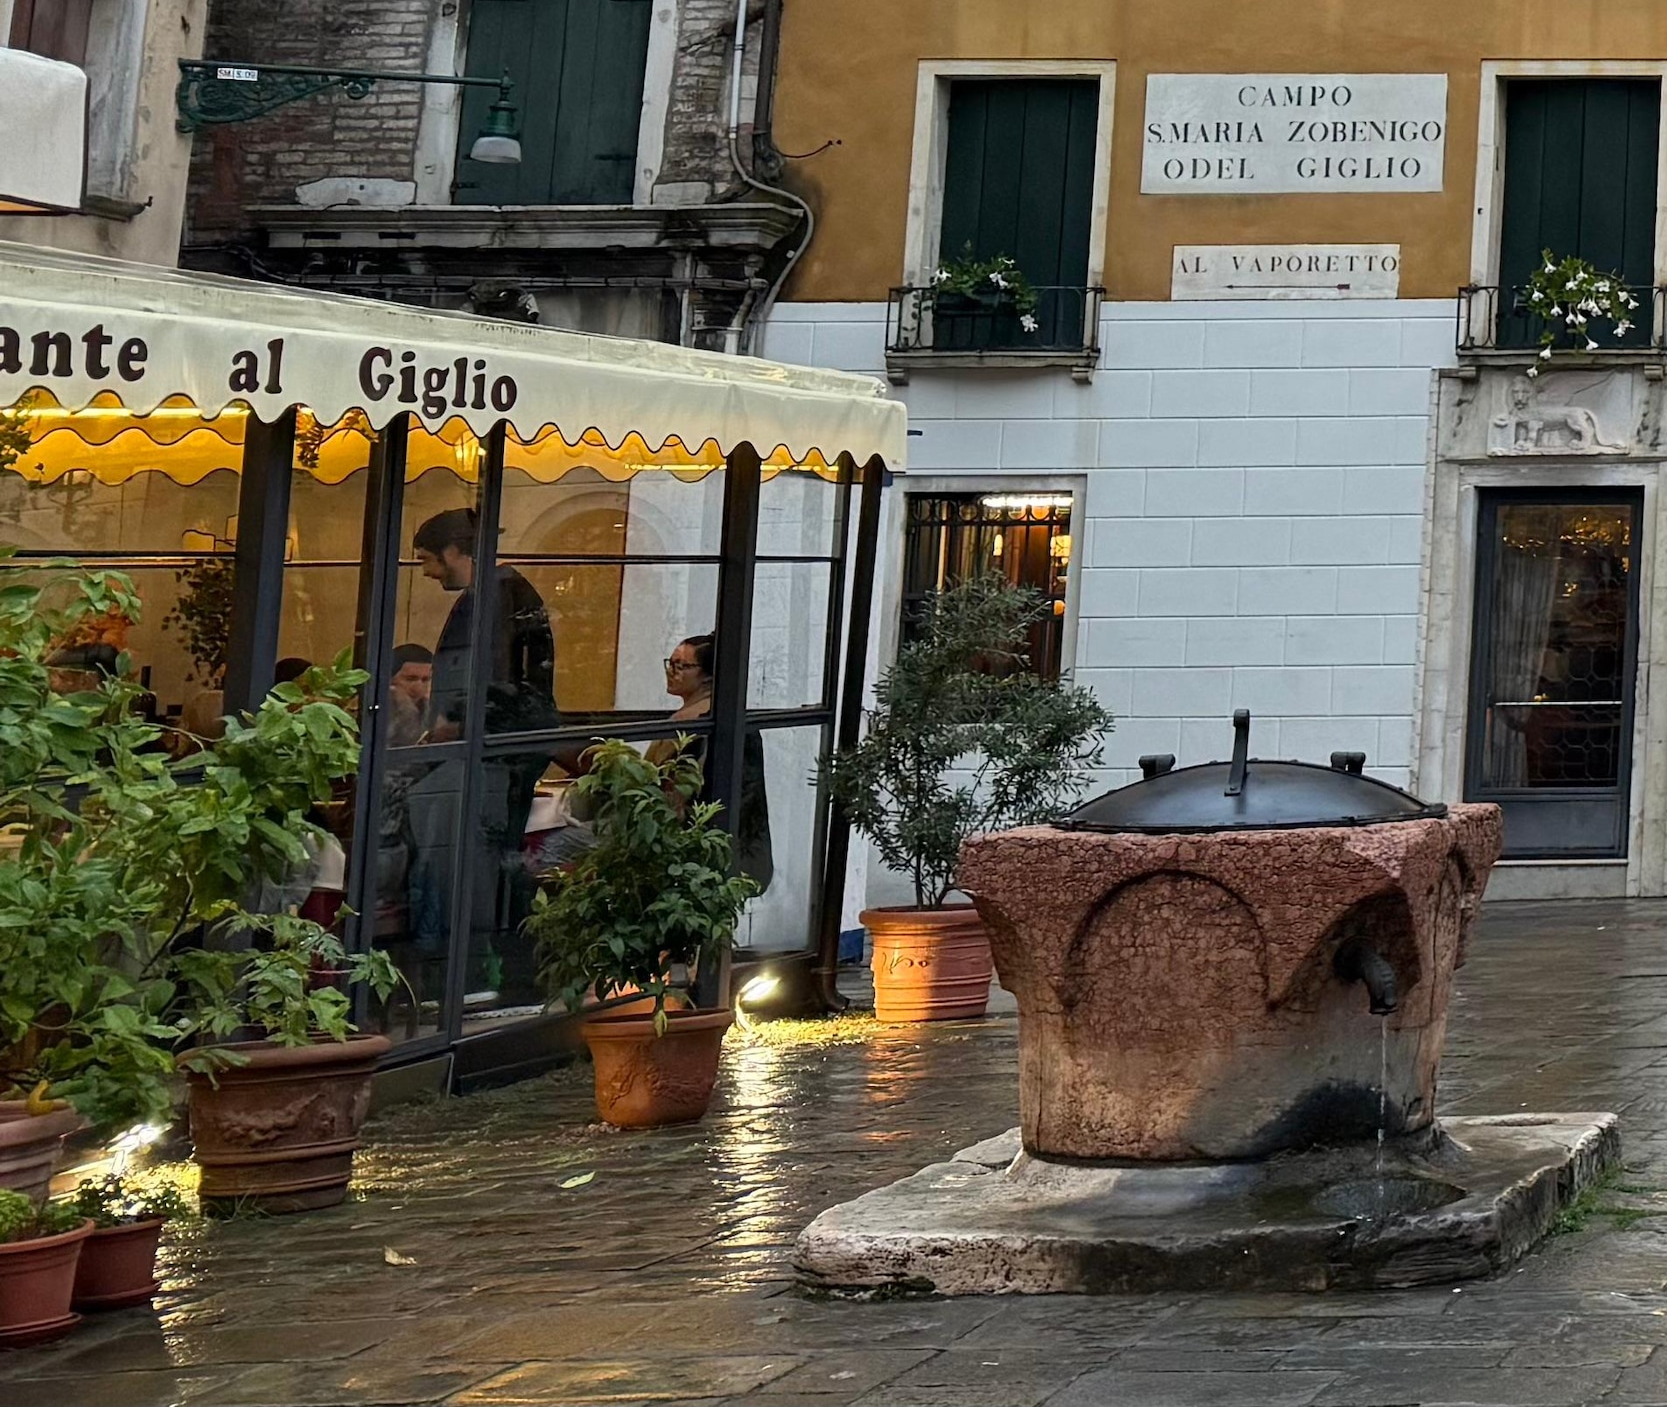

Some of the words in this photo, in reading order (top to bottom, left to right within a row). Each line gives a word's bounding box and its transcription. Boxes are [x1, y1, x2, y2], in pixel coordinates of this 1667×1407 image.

[1237, 85, 1353, 108] CAMPO
[1286, 119, 1443, 143] ZOBENIGO
[1296, 156, 1422, 179] GIGLIO
[1175, 255, 1208, 274] AL
[1231, 254, 1398, 273] VAPORETTO
[228, 338, 284, 394] al
[358, 346, 518, 420] Giglio
